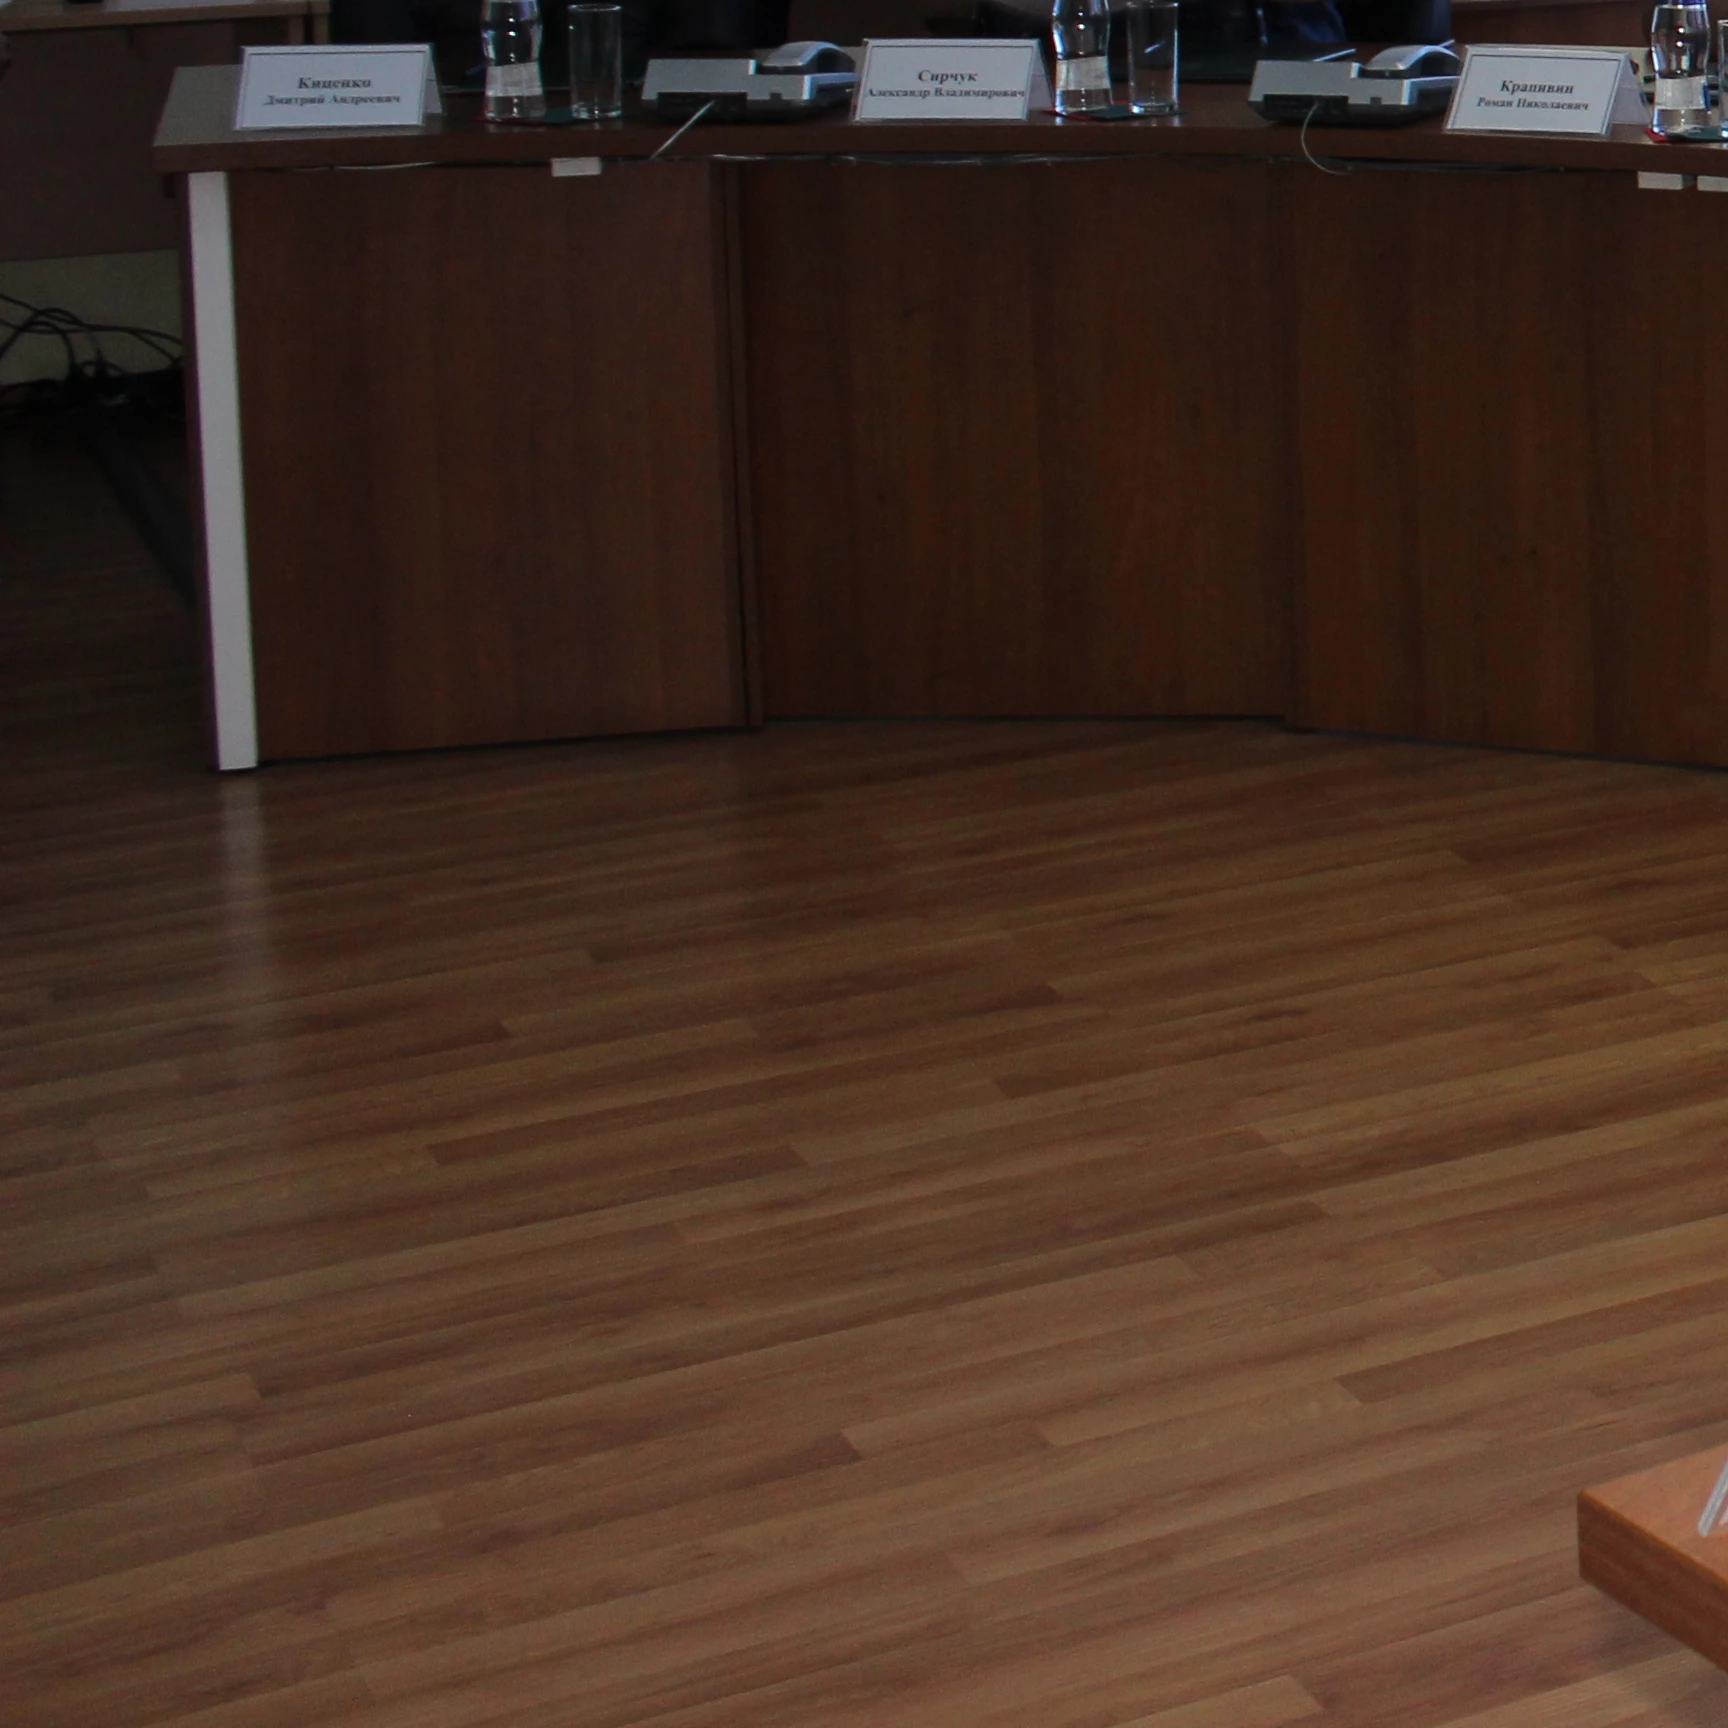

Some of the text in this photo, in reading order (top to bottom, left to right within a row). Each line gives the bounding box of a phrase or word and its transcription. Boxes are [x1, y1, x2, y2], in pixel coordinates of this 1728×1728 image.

[298, 76, 372, 90] Киценко
[918, 70, 978, 85] Сирчук
[868, 87, 1025, 100] Александр Владимирович
[1500, 80, 1575, 95] Крапивин
[263, 94, 401, 107] Дмитрий Андреевич
[1476, 97, 1589, 112] Роман Николаевич
